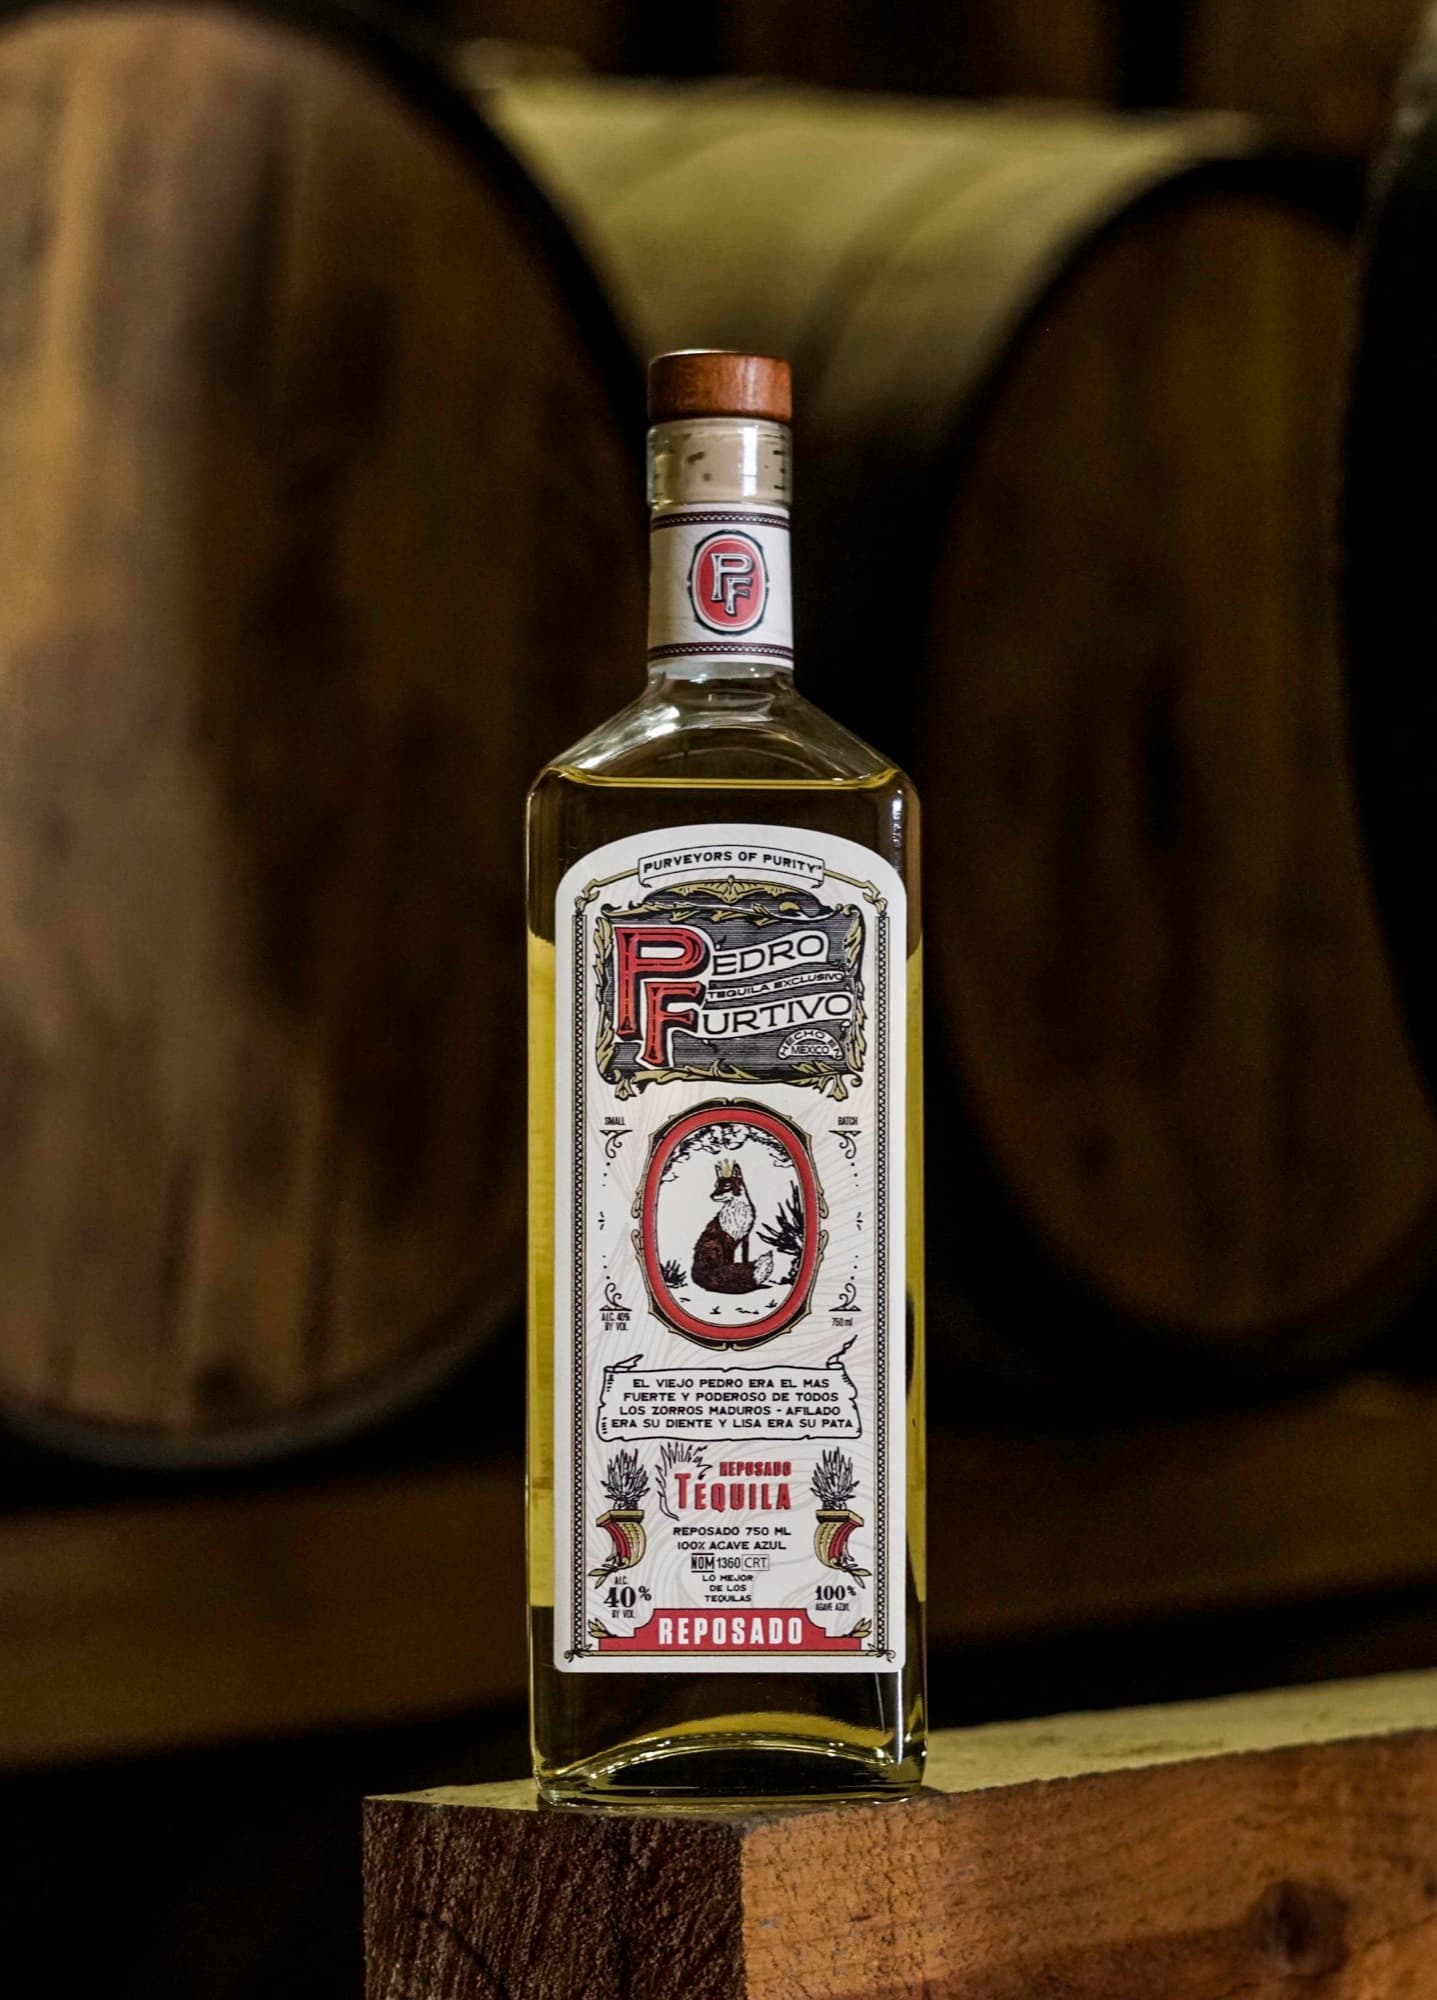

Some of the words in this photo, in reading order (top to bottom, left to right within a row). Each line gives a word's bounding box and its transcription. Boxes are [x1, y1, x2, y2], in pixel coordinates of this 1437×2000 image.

[643, 851, 732, 873] PURVEYORS
[738, 852, 757, 862] OF
[614, 926, 824, 1038] PEDRO
[707, 984, 770, 999] TEQUILA
[774, 973, 845, 988] EXCLUSIVO
[645, 981, 850, 1065] FURTIVO
[779, 1030, 825, 1057] HECHO
[632, 1379, 649, 1388] EL
[656, 1379, 694, 1388] VIEJO
[699, 1379, 743, 1388] PEDRO
[749, 1379, 775, 1388] ERA
[780, 1379, 797, 1388] EL
[803, 1379, 829, 1388] MAS
[623, 1392, 675, 1402] FUERTE
[680, 1392, 690, 1402] Y
[696, 1392, 766, 1402] PODEROSO
[772, 1392, 790, 1402] DE
[796, 1392, 839, 1402] TODOS
[619, 1406, 646, 1416] LOS
[651, 1406, 703, 1416] ZORROS
[709, 1406, 771, 1416] MADUROS
[786, 1406, 840, 1416] AFILADO
[611, 1419, 637, 1428] ERA
[643, 1419, 660, 1428] SU
[666, 1419, 712, 1428] DIENTE
[718, 1419, 727, 1428] Y
[733, 1419, 761, 1428] LISA
[767, 1419, 794, 1428] ERA
[799, 1419, 816, 1428] SU
[822, 1419, 853, 1428] PATA
[719, 1461, 792, 1477] REPOSADO
[674, 1473, 791, 1512] TEQUILA
[672, 1527, 740, 1536] REPOSADO
[745, 1527, 769, 1536] 750
[774, 1527, 792, 1536] ML
[677, 1541, 706, 1550] 100%
[709, 1541, 750, 1550] AGAVE
[754, 1541, 787, 1550] AZUL
[691, 1556, 715, 1569] NOM
[716, 1556, 741, 1569] 1360
[744, 1557, 768, 1568] CRT
[603, 1585, 652, 1608] 40%
[815, 1585, 857, 1601] 100%
[658, 1617, 803, 1645] REPOSADO
